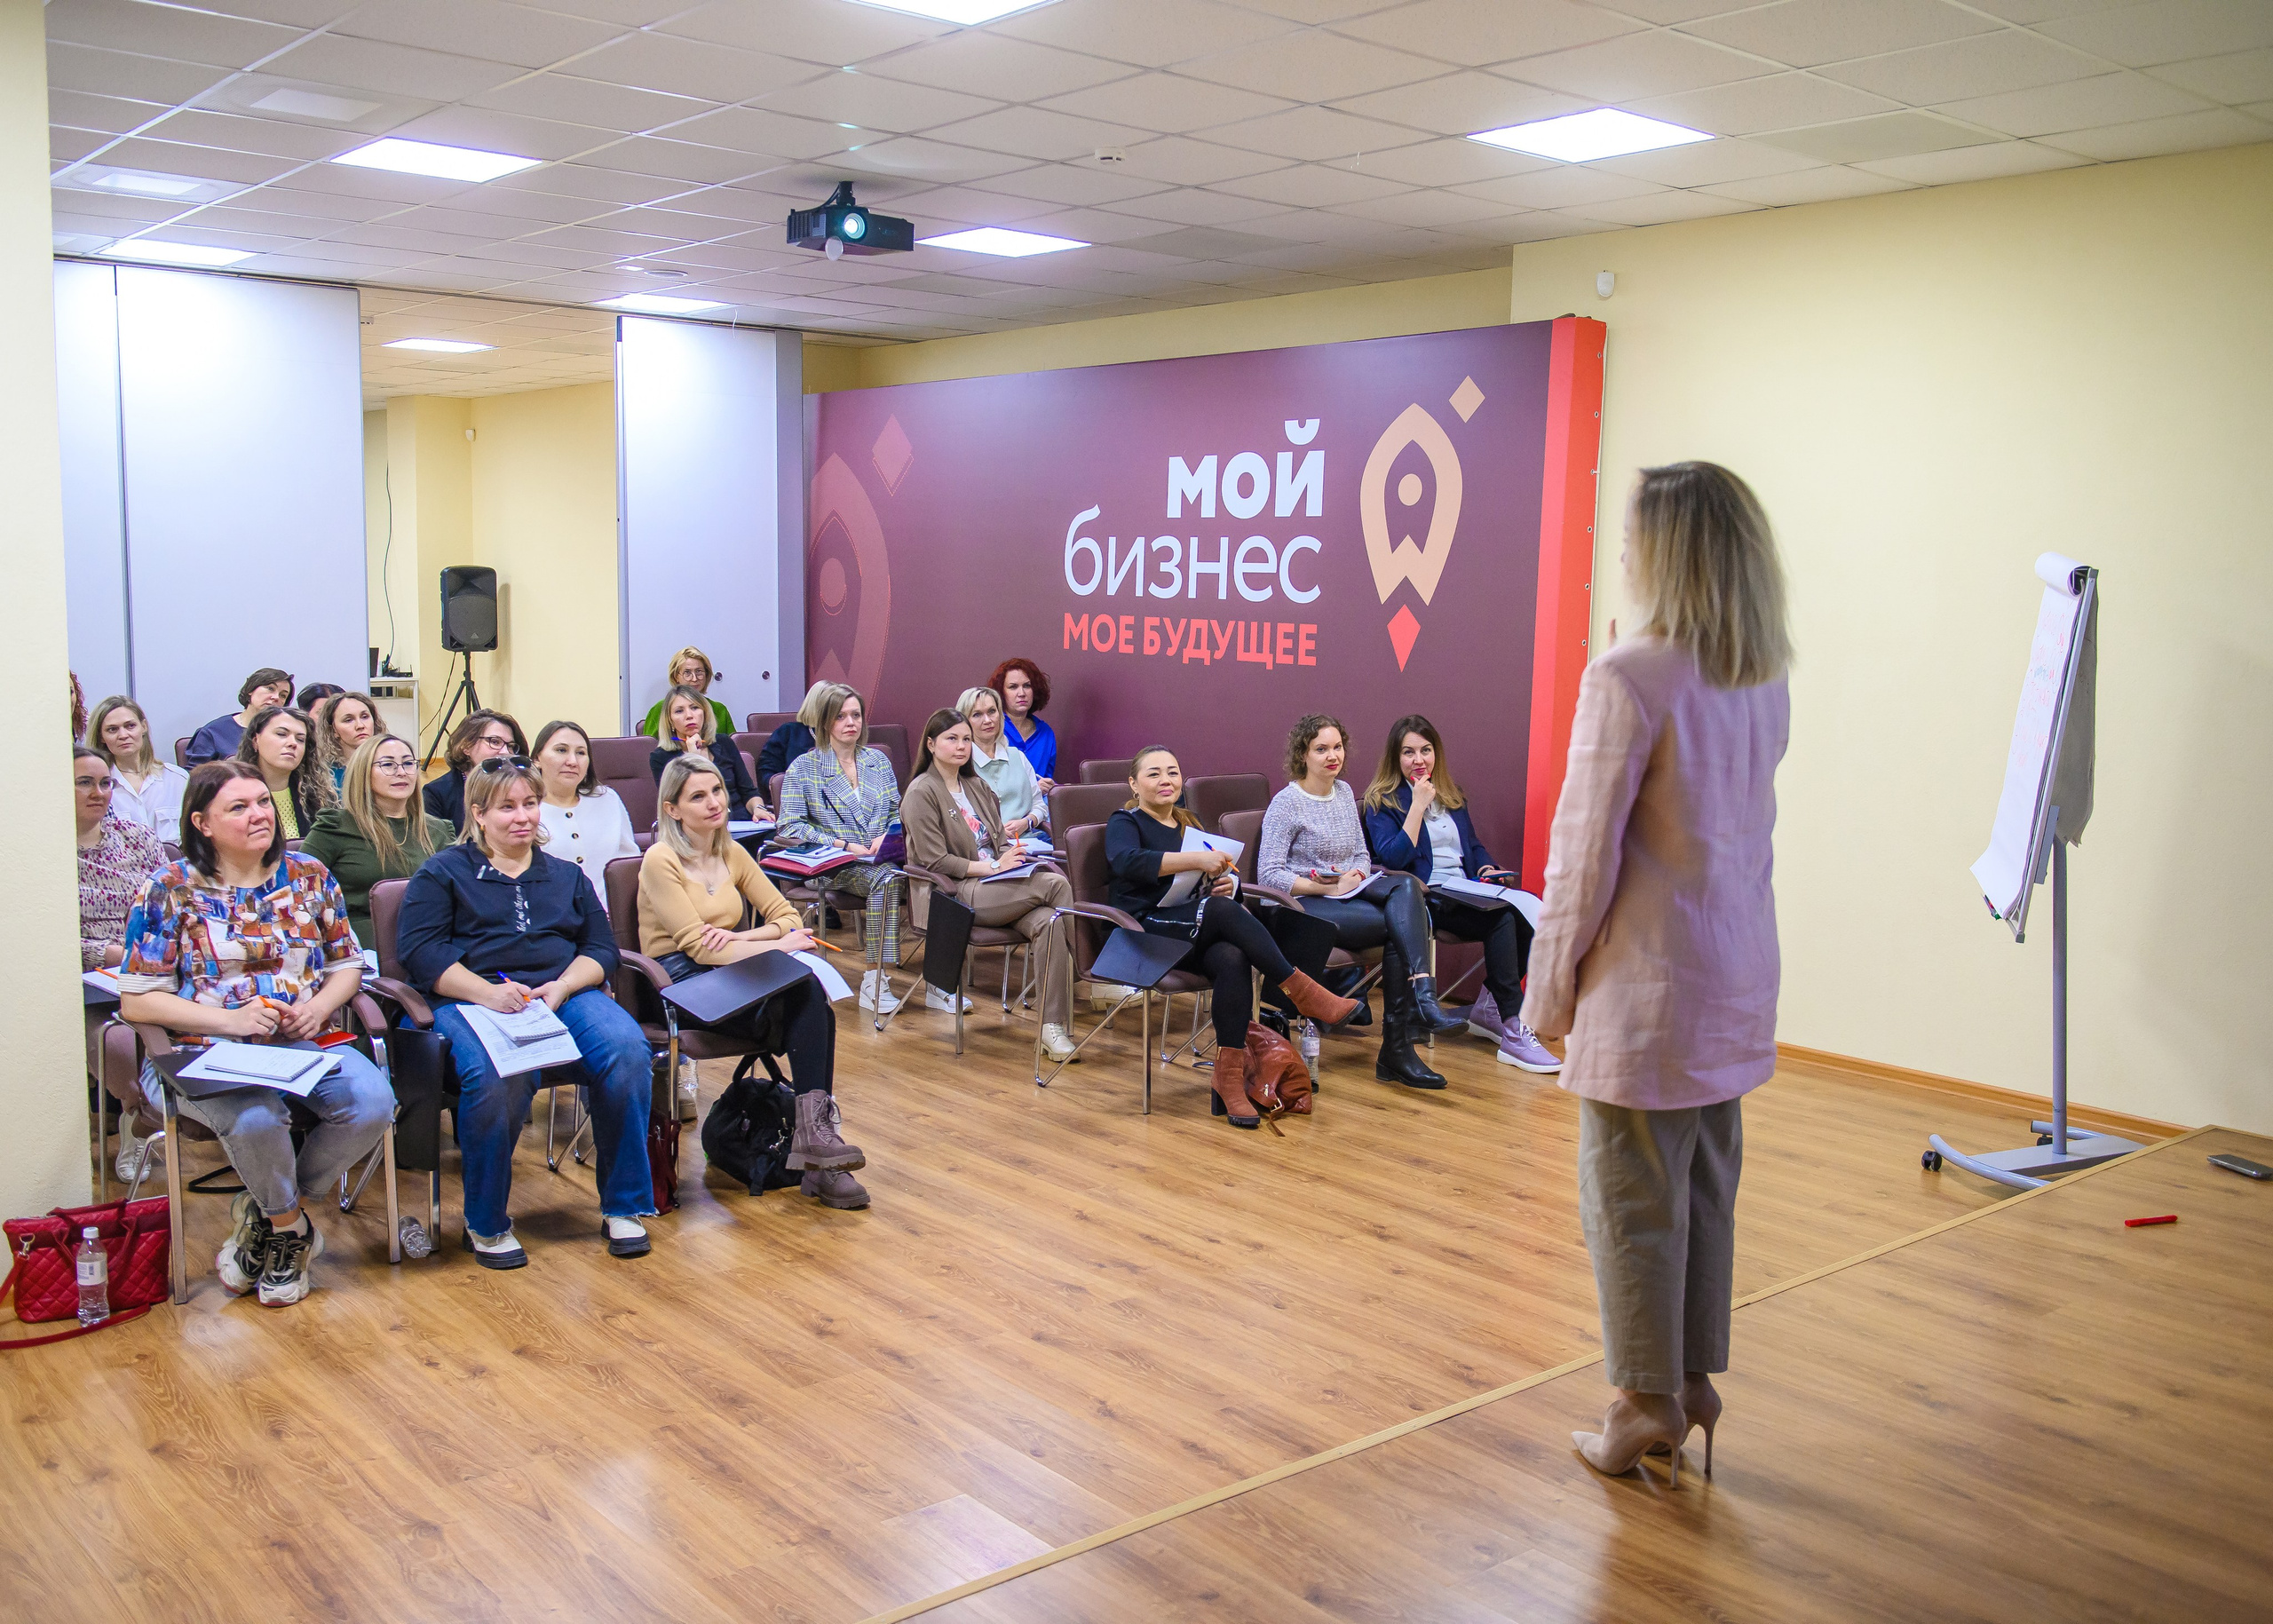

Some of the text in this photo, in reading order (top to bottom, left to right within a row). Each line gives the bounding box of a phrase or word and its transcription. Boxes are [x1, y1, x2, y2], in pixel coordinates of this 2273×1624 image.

[1166, 418, 1326, 519] мой
[1064, 503, 1323, 604] бизнес
[1063, 612, 1319, 670] МОЕ БУДУЩЕЕ
